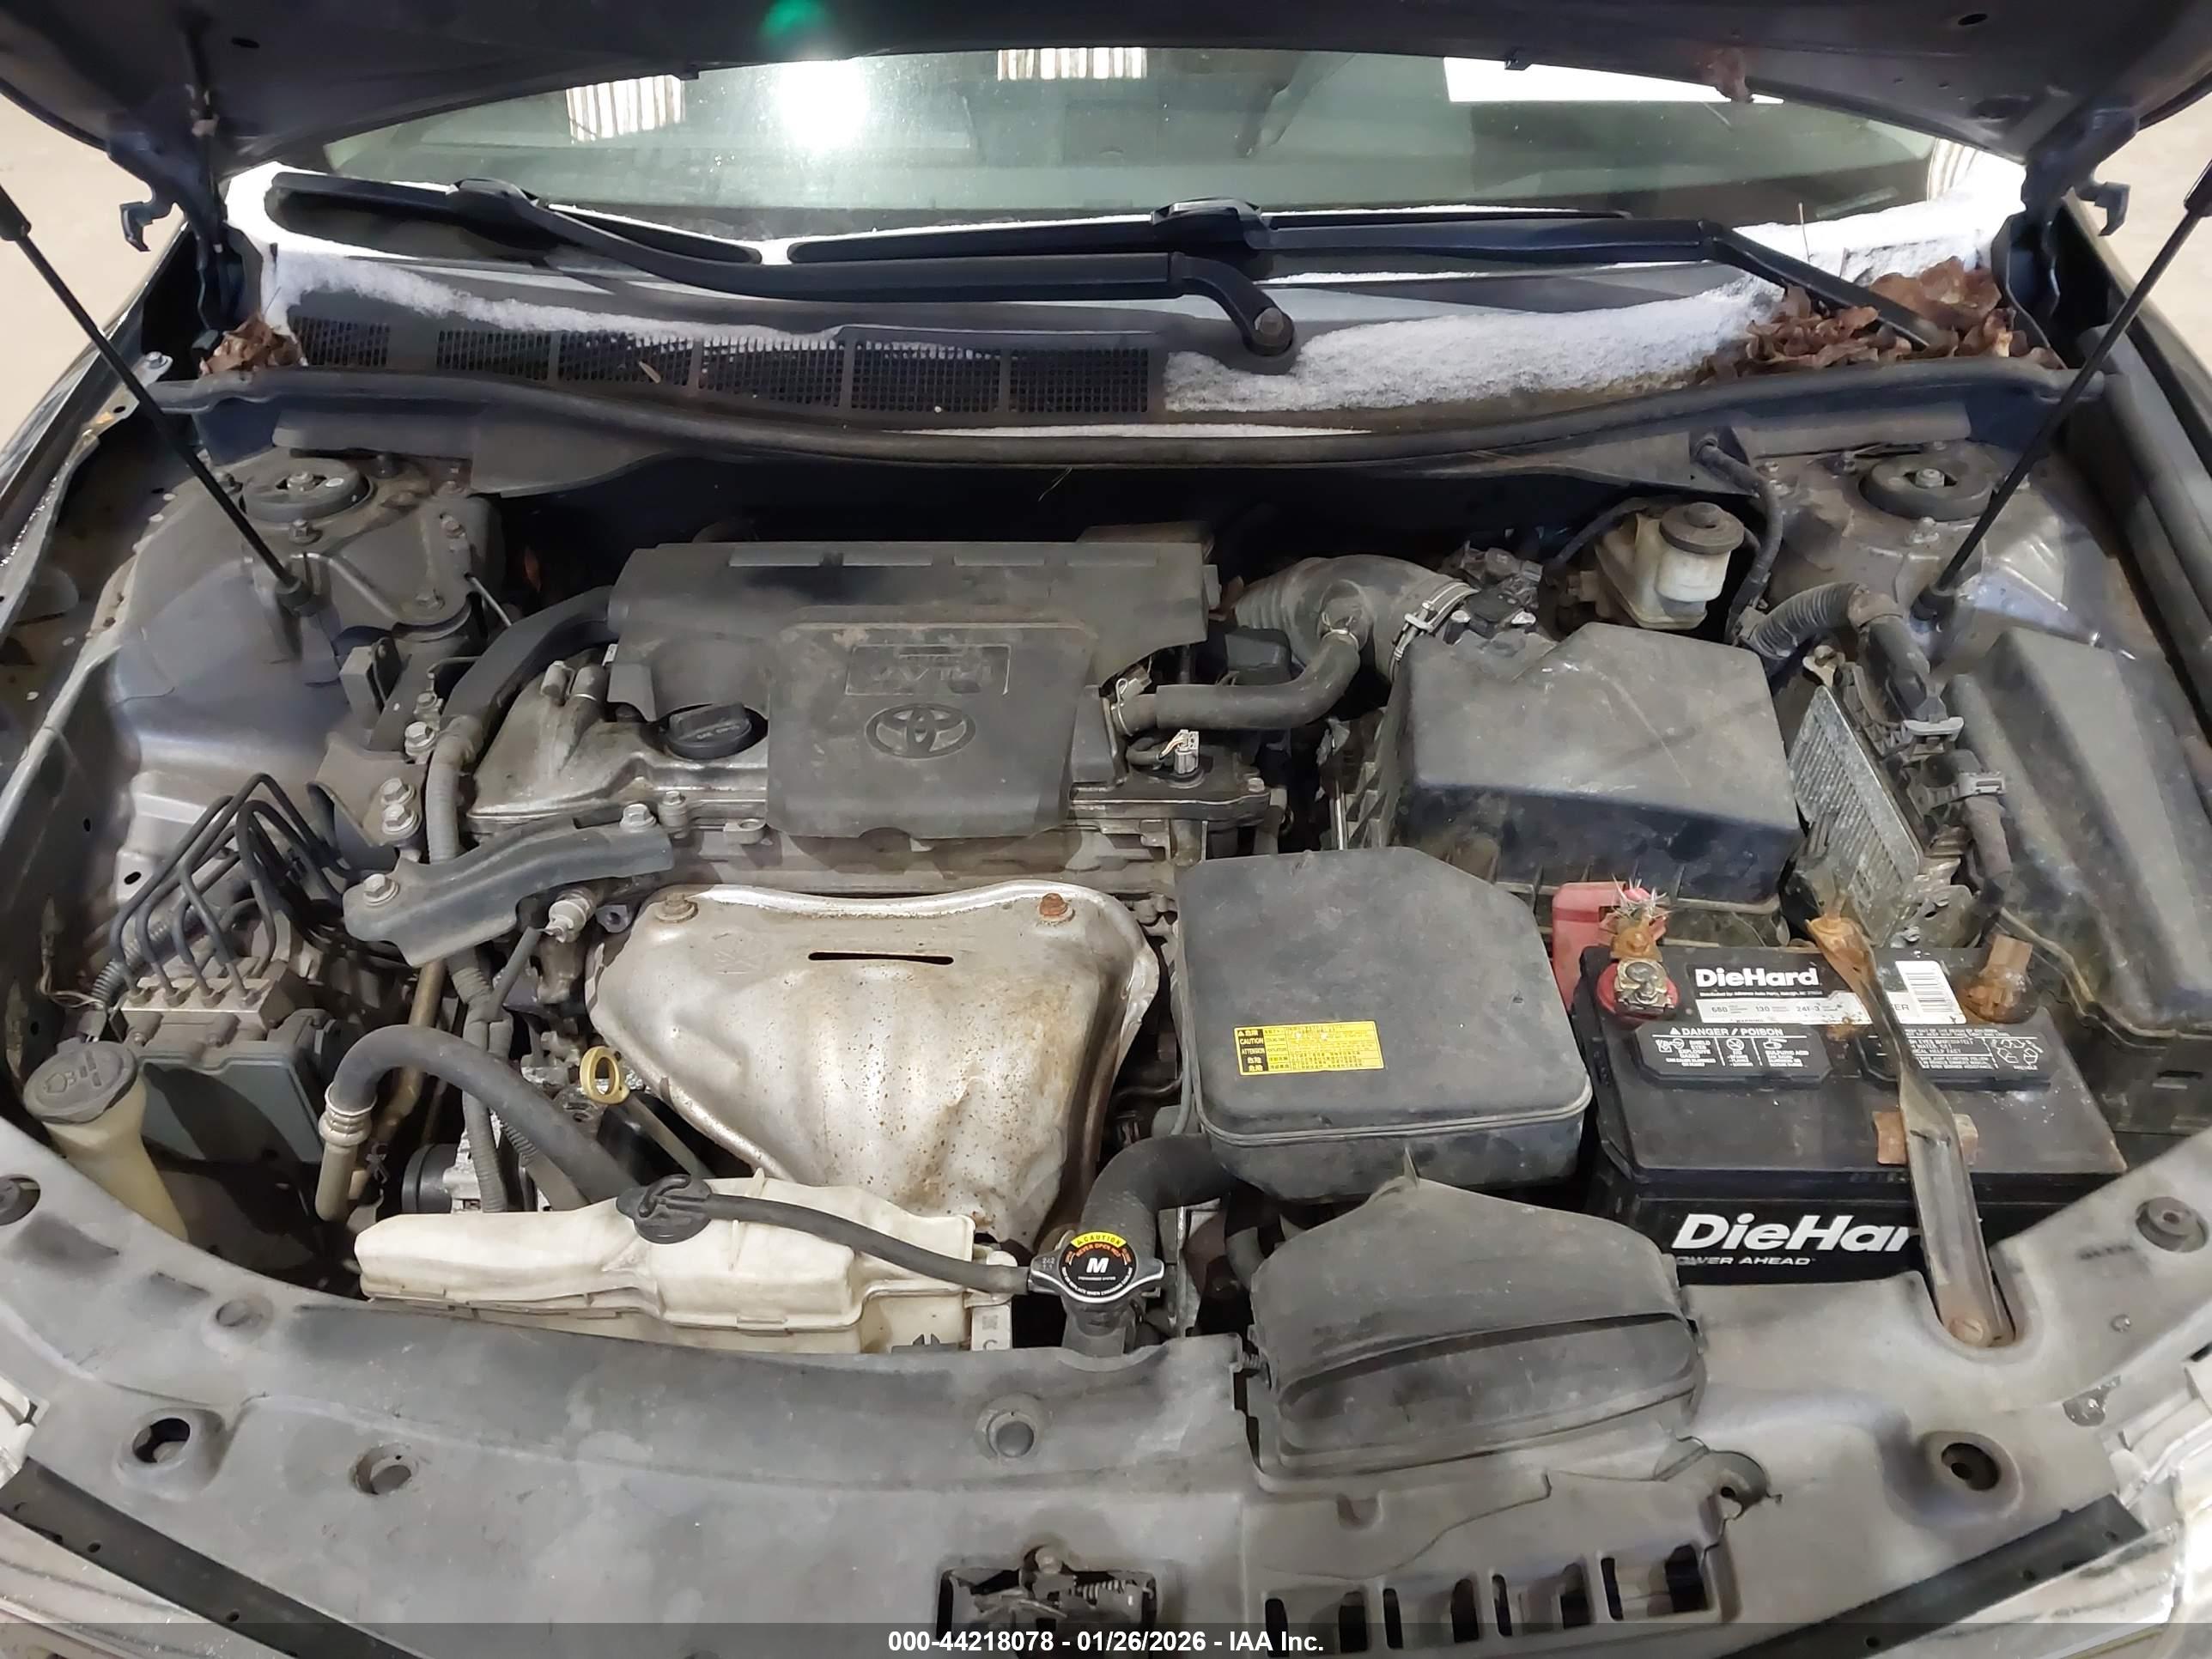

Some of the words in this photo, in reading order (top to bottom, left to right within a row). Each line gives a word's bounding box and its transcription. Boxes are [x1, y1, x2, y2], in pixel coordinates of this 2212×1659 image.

[1695, 968, 1820, 987] DieHard
[1672, 1212, 1911, 1252] DieHar
[1084, 1235, 1121, 1245] CAUTION
[1094, 1243, 1111, 1251] OPEN
[1085, 1257, 1109, 1273] M
[1738, 1256, 1811, 1266] AHEAD
